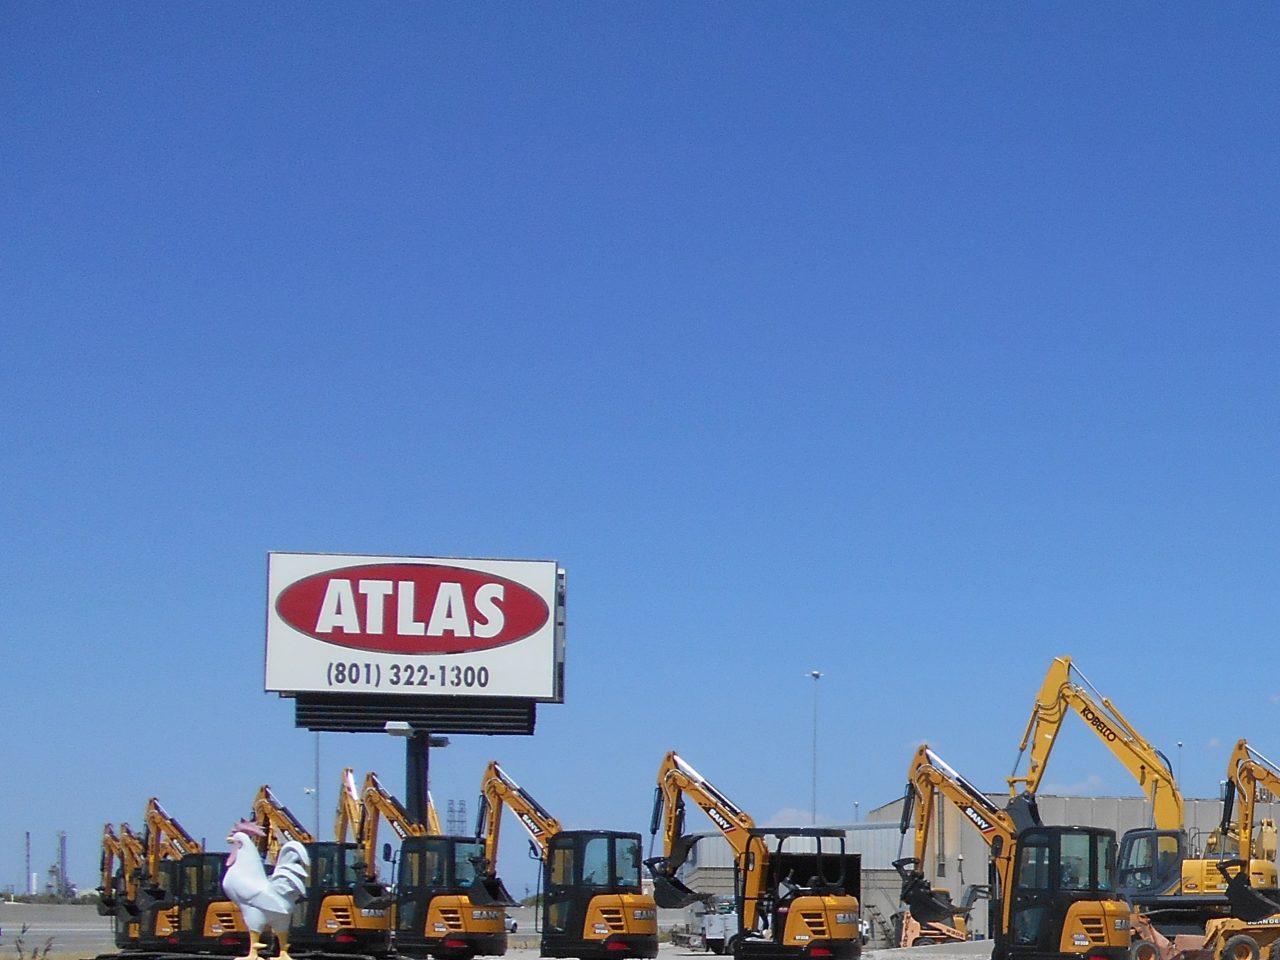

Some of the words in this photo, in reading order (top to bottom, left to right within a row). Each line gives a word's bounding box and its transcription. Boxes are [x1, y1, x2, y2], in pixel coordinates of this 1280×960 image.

[315, 578, 505, 639] ATLAS
[327, 662, 381, 687] (801)
[389, 663, 489, 688] 322-1300
[1080, 705, 1117, 742] KOBELCO
[522, 814, 541, 833] SANY
[708, 808, 730, 829] SANY
[965, 807, 989, 829] SANY
